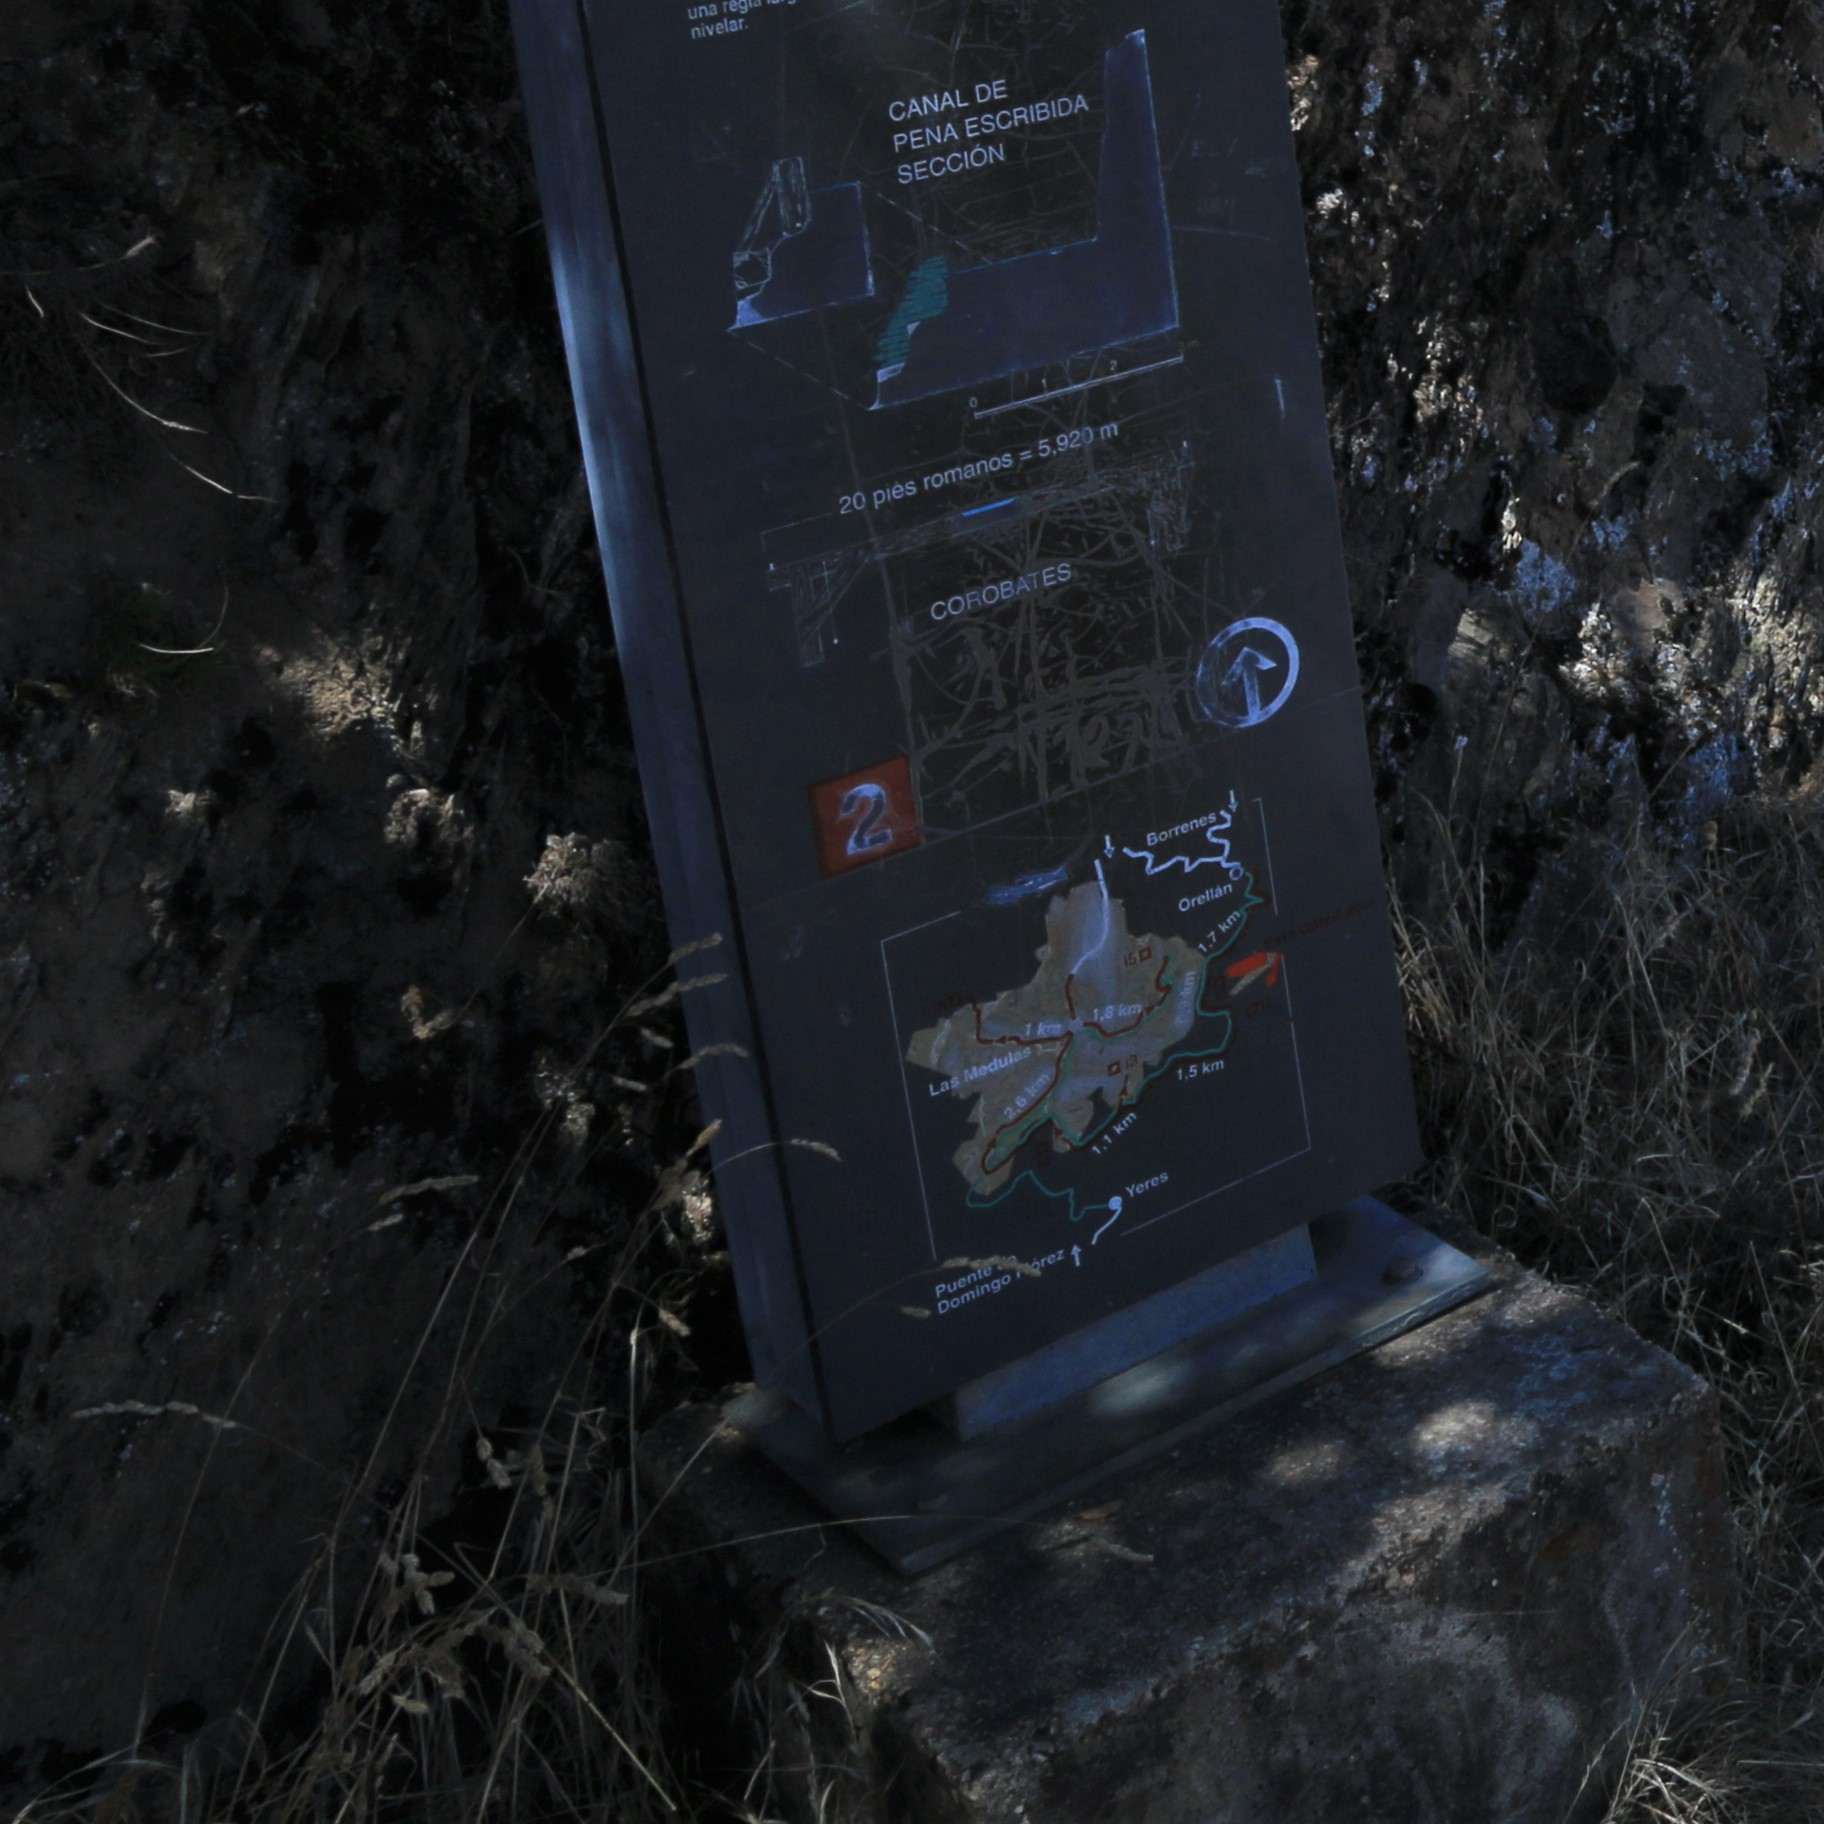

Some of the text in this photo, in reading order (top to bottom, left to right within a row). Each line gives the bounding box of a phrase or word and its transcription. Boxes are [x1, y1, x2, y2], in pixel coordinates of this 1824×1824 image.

[687, 3, 717, 19] una
[691, 11, 747, 39] nivelar.
[888, 79, 1009, 122] CANAL DE
[964, 94, 1090, 138] ESCRIBIDA
[897, 143, 1005, 184] SECCIÓN
[839, 492, 866, 515] 20
[923, 452, 1014, 491] romanos
[1038, 426, 1094, 458] 5,920
[1100, 422, 1119, 441] m
[930, 562, 1072, 620] COROBATES
[838, 783, 893, 857] 2
[1145, 812, 1217, 846] Borrenes
[1178, 883, 1232, 912] Orellán
[1217, 911, 1241, 933] km
[1118, 1003, 1143, 1018] km
[1202, 1059, 1224, 1074] km
[928, 1075, 960, 1096] Las
[1112, 1112, 1137, 1135] km
[1124, 1172, 1169, 1198] Yeres
[935, 1266, 993, 1298] Puente
[937, 1274, 1011, 1314] Domingo
